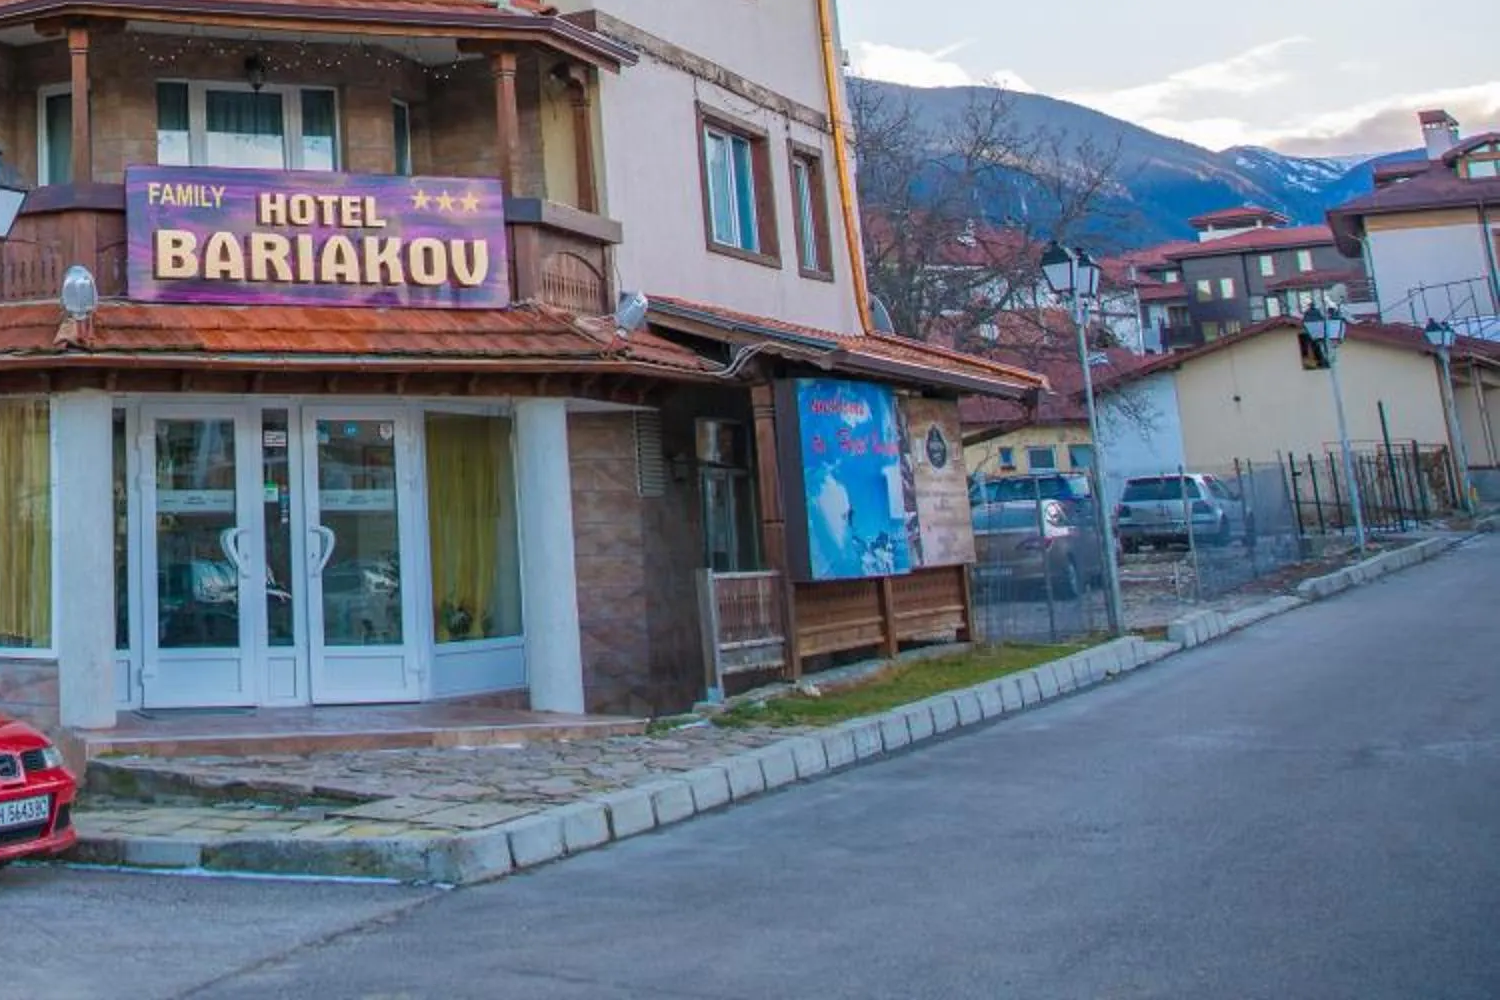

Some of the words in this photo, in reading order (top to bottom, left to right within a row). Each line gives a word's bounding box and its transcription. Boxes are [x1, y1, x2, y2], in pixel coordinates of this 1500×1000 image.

[148, 182, 226, 208] FAMILY
[257, 192, 387, 228] HOTEL
[153, 229, 489, 286] BARIAKOV
